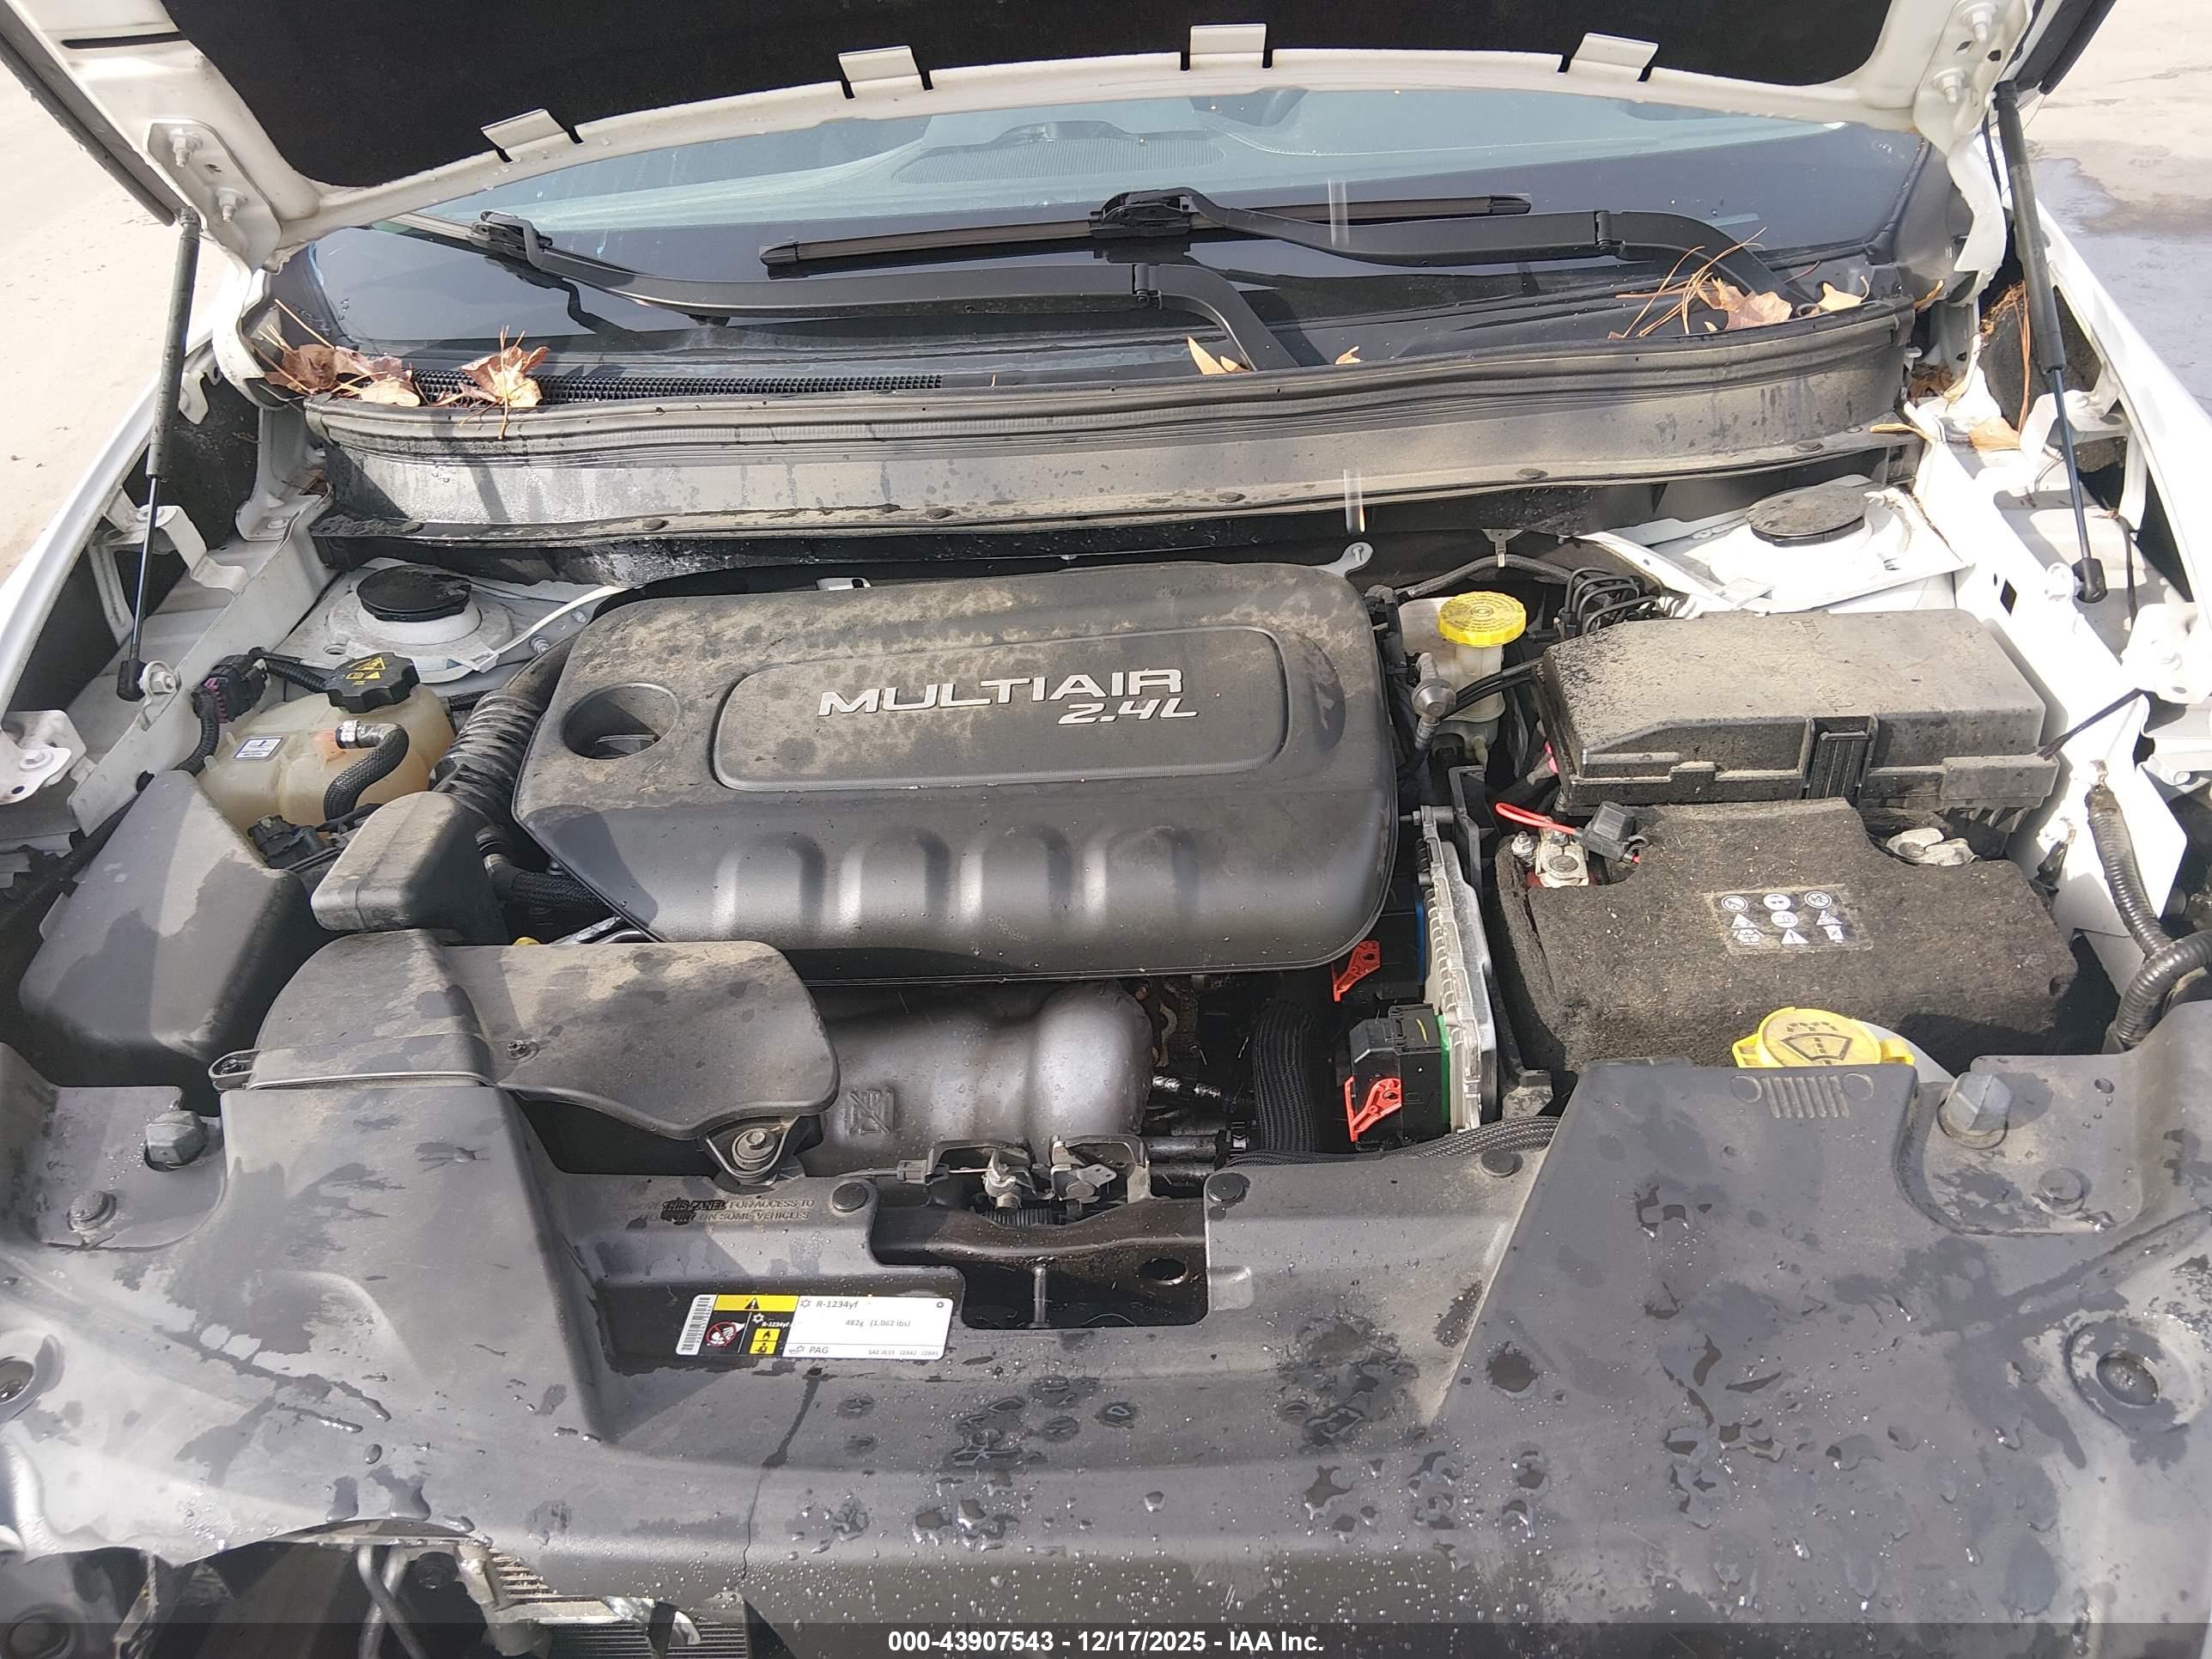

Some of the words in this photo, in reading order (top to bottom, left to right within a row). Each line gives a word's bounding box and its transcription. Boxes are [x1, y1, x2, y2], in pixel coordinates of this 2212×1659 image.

[817, 669, 1183, 716] MULTIAIR
[1058, 697, 1199, 725] 2.4L
[690, 1200, 725, 1210] PANEL
[754, 1200, 798, 1208] ACCESS
[756, 1211, 810, 1219] VEHICLES
[816, 1300, 859, 1309] R-1234yf
